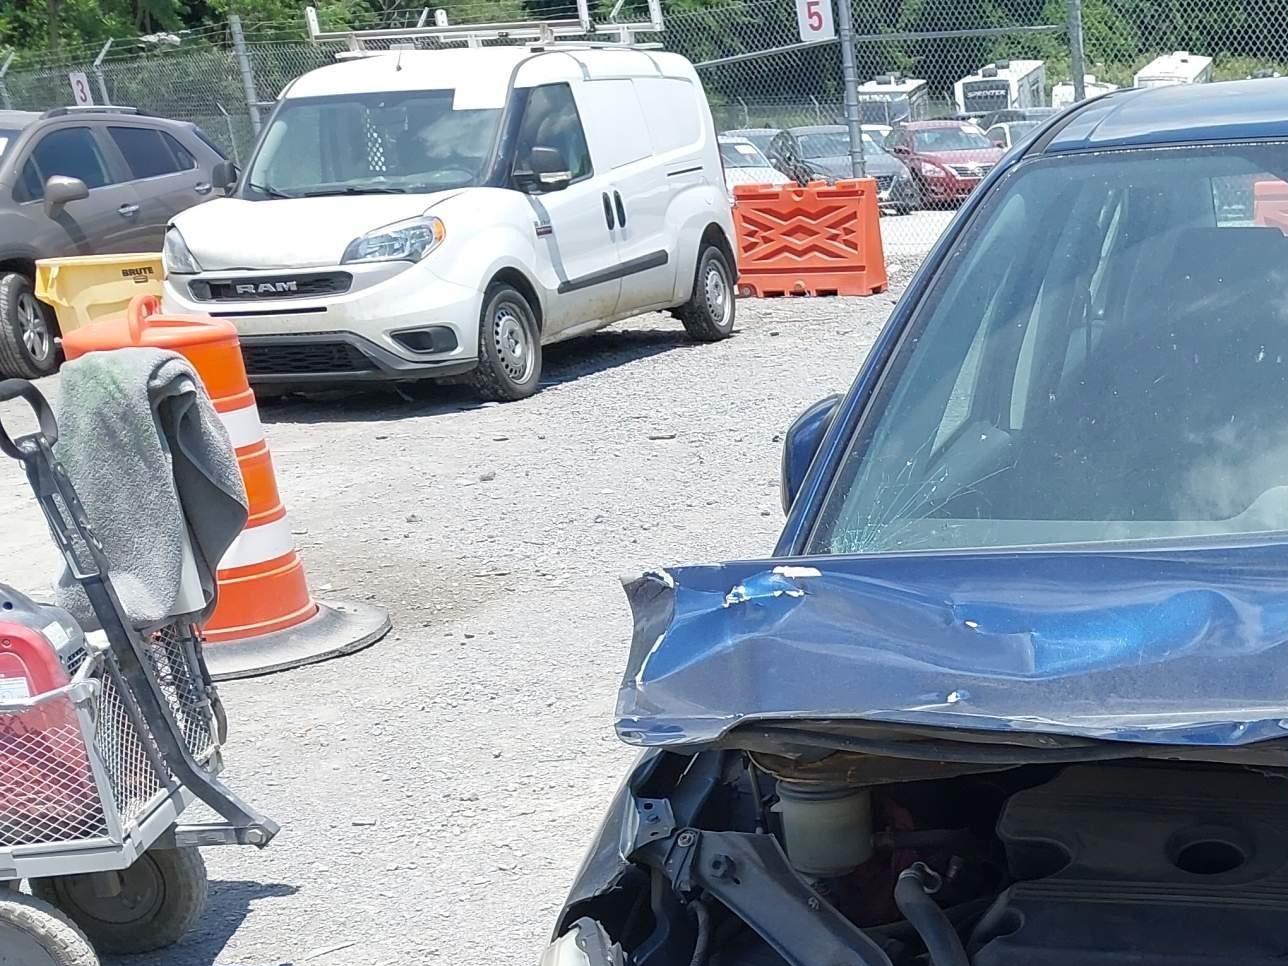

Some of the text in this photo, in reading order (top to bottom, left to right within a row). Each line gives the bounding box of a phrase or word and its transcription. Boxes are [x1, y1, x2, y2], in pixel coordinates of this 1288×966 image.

[807, 1, 823, 31] 5
[76, 79, 87, 102] 3
[122, 267, 154, 277] BRUTE
[236, 281, 298, 294] RAM
